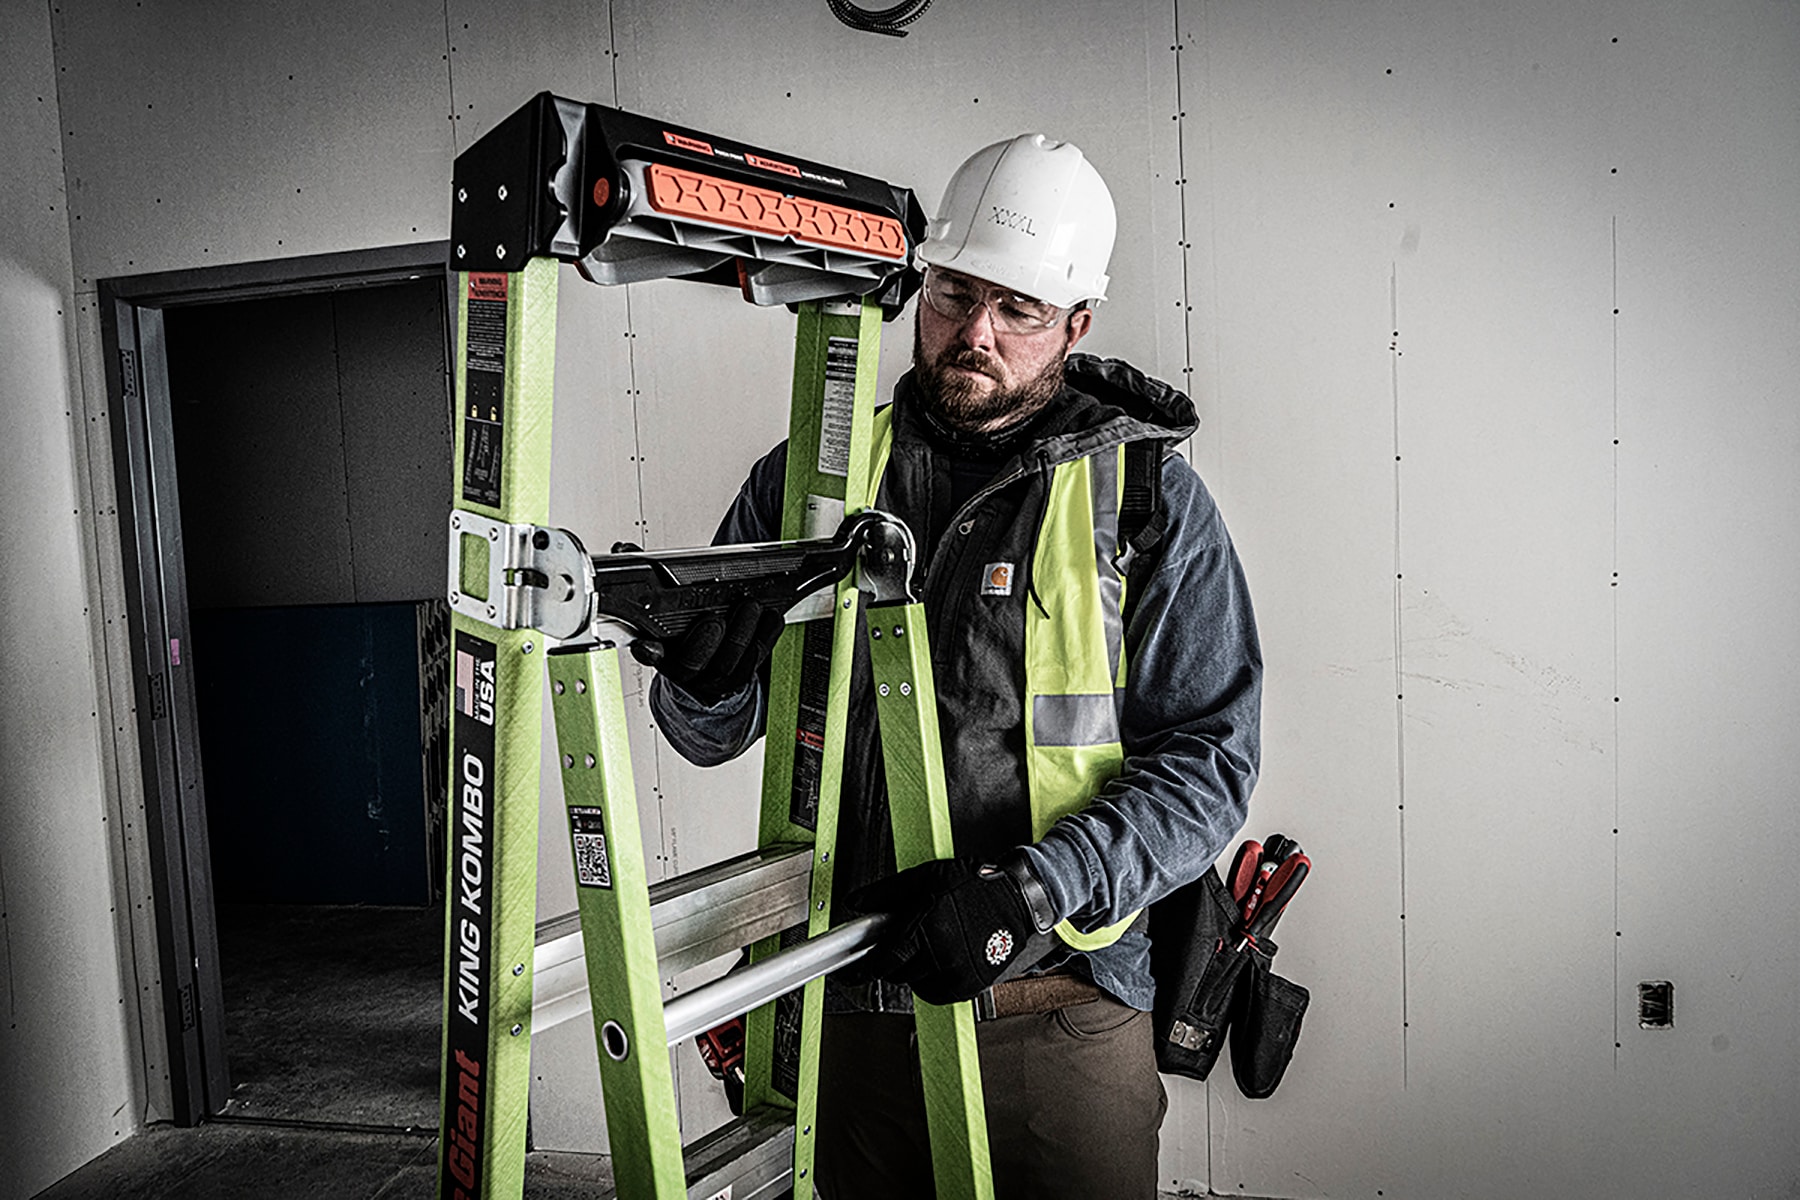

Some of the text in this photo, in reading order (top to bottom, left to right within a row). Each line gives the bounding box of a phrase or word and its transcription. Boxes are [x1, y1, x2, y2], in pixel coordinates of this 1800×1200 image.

[480, 660, 495, 726] USA
[458, 753, 484, 1025] KING KOMBO
[449, 1049, 480, 1190] Giant
